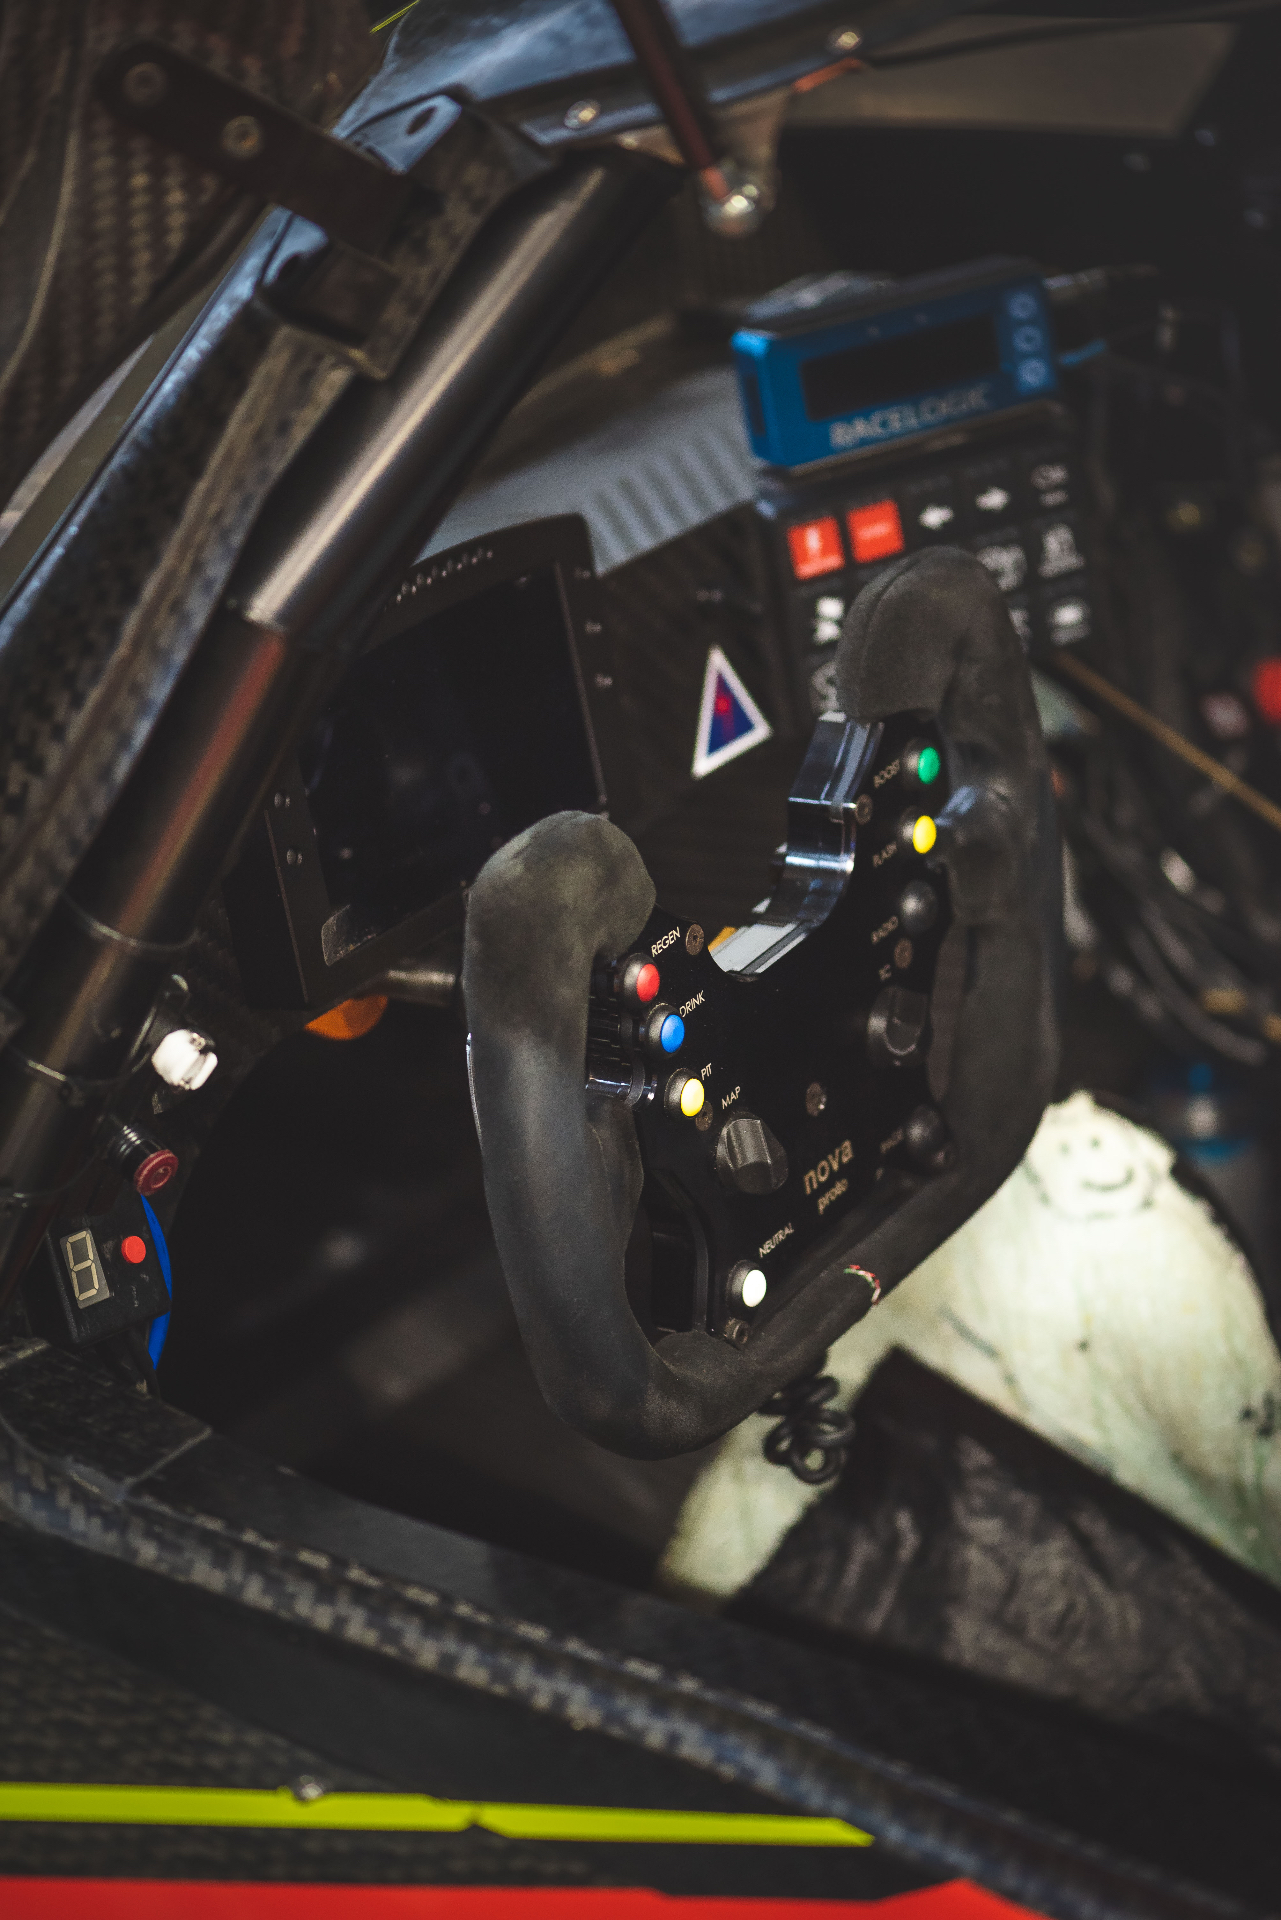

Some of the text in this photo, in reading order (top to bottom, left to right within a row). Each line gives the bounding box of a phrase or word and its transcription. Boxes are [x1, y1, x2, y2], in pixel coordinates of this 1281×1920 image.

[650, 926, 681, 958] REGEN
[679, 990, 706, 1018] DRINK
[700, 1063, 712, 1081] PIT
[721, 1086, 741, 1110] MAP
[803, 1139, 855, 1195] nova
[758, 1222, 795, 1258] NEUTRAL
